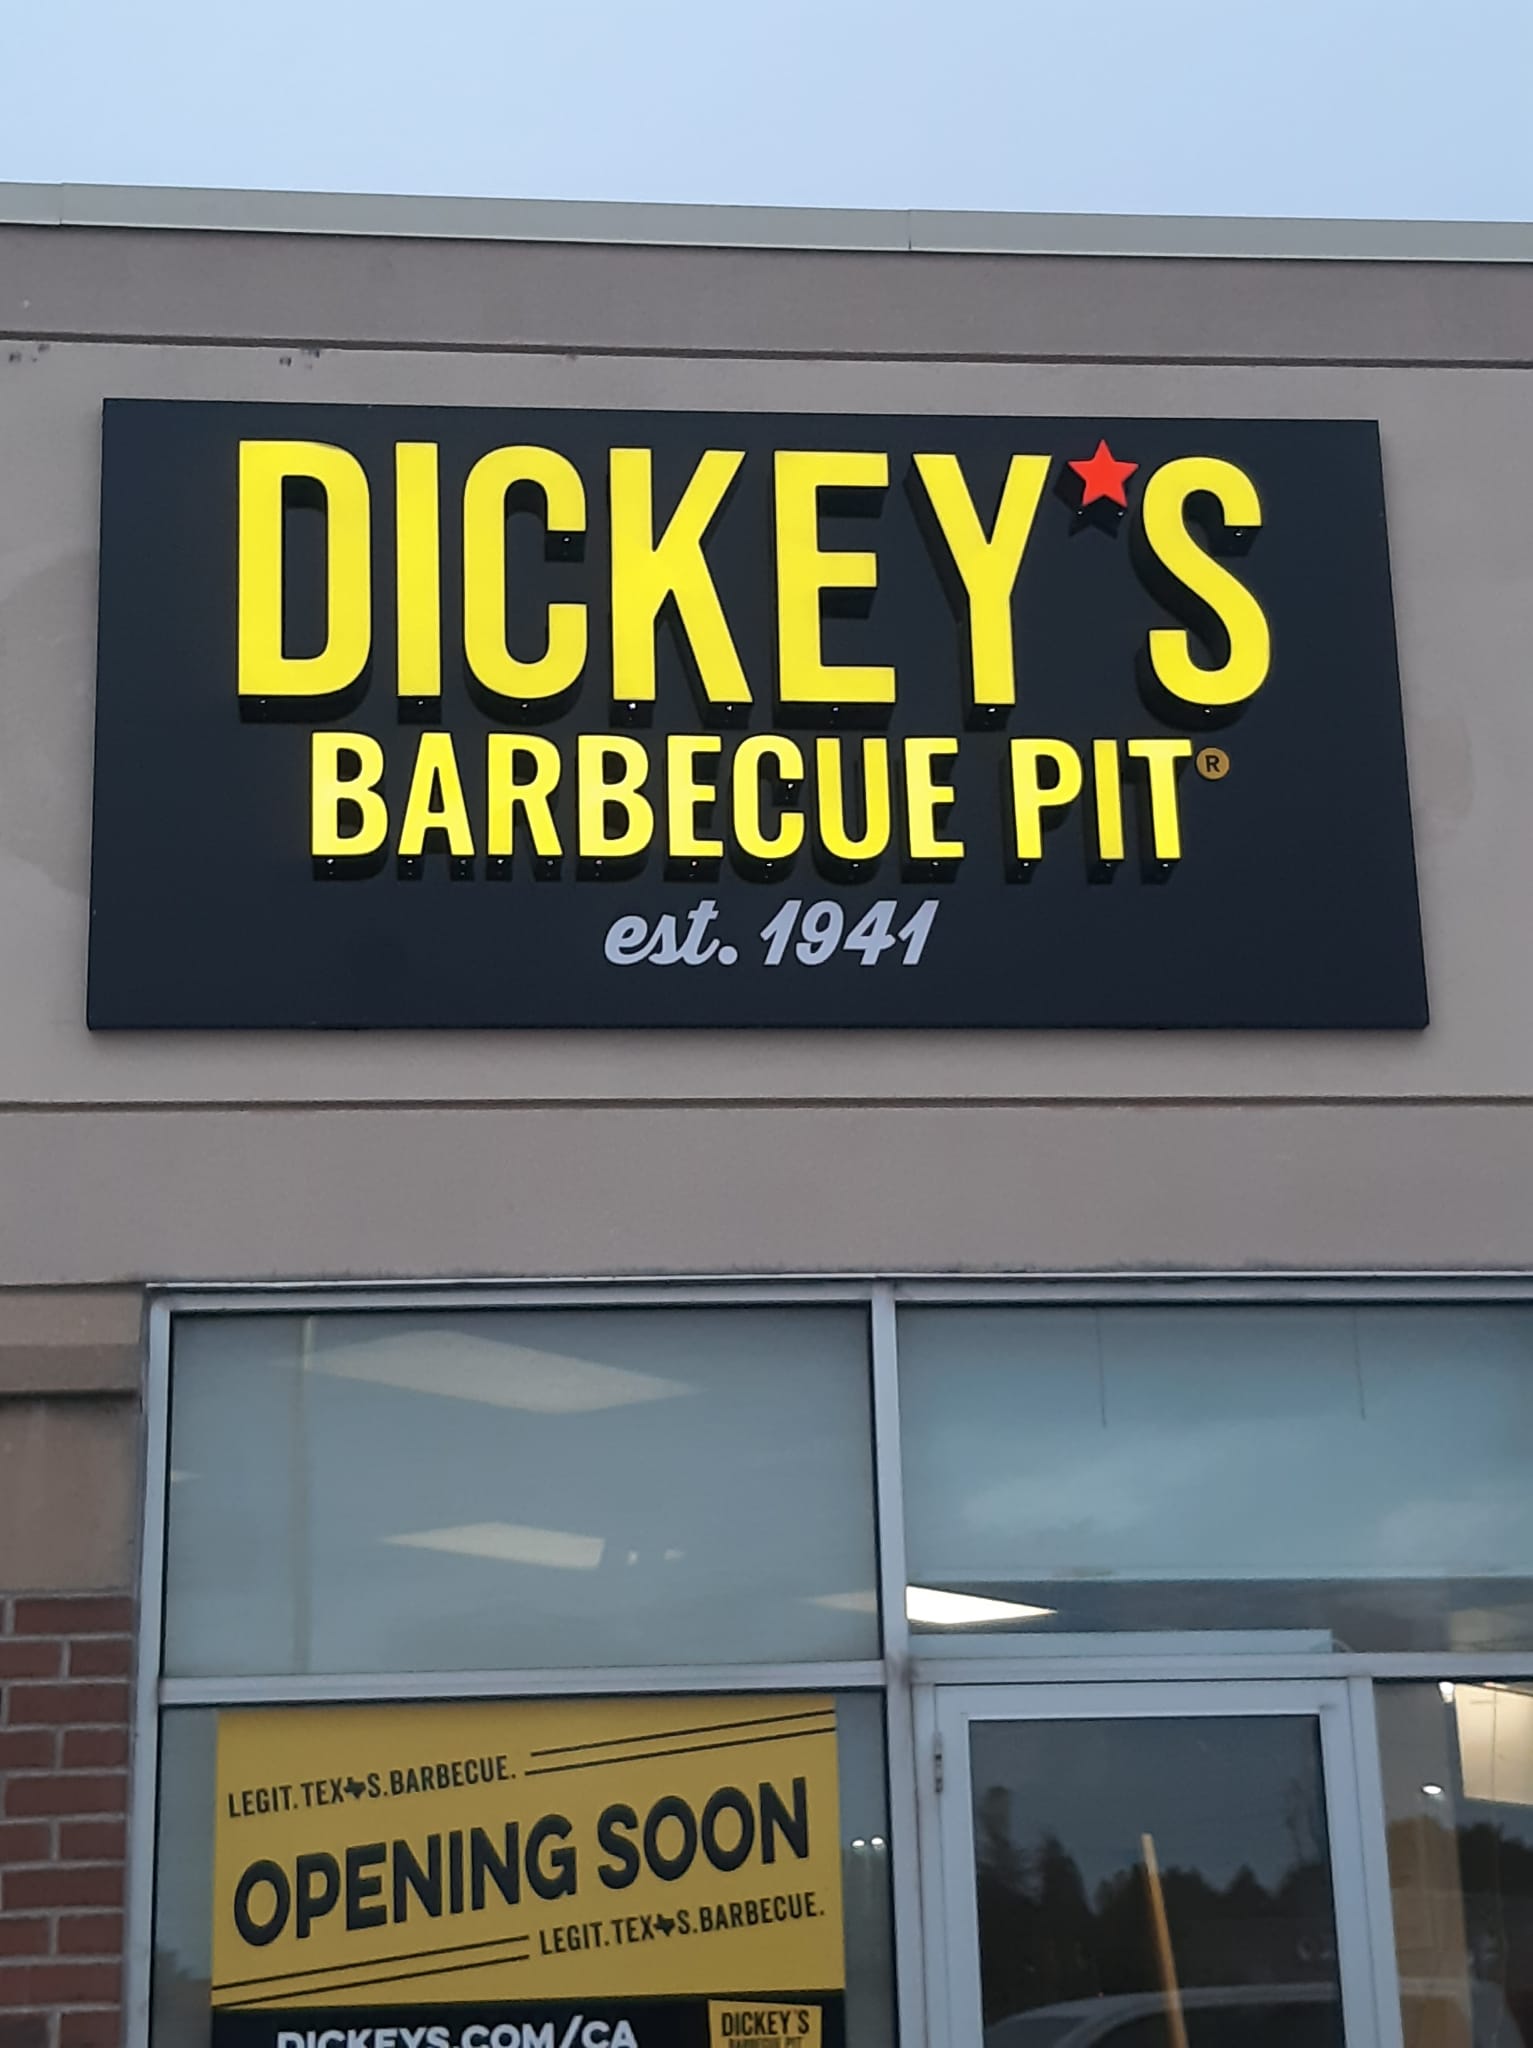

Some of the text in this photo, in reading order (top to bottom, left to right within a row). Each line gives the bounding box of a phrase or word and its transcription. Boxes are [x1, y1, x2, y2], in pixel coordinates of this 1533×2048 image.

[237, 439, 1271, 705] DICKEY'S
[310, 731, 966, 860] BARBECUE
[604, 900, 940, 966] est. 1941
[233, 1776, 809, 1947] OPENING SOON
